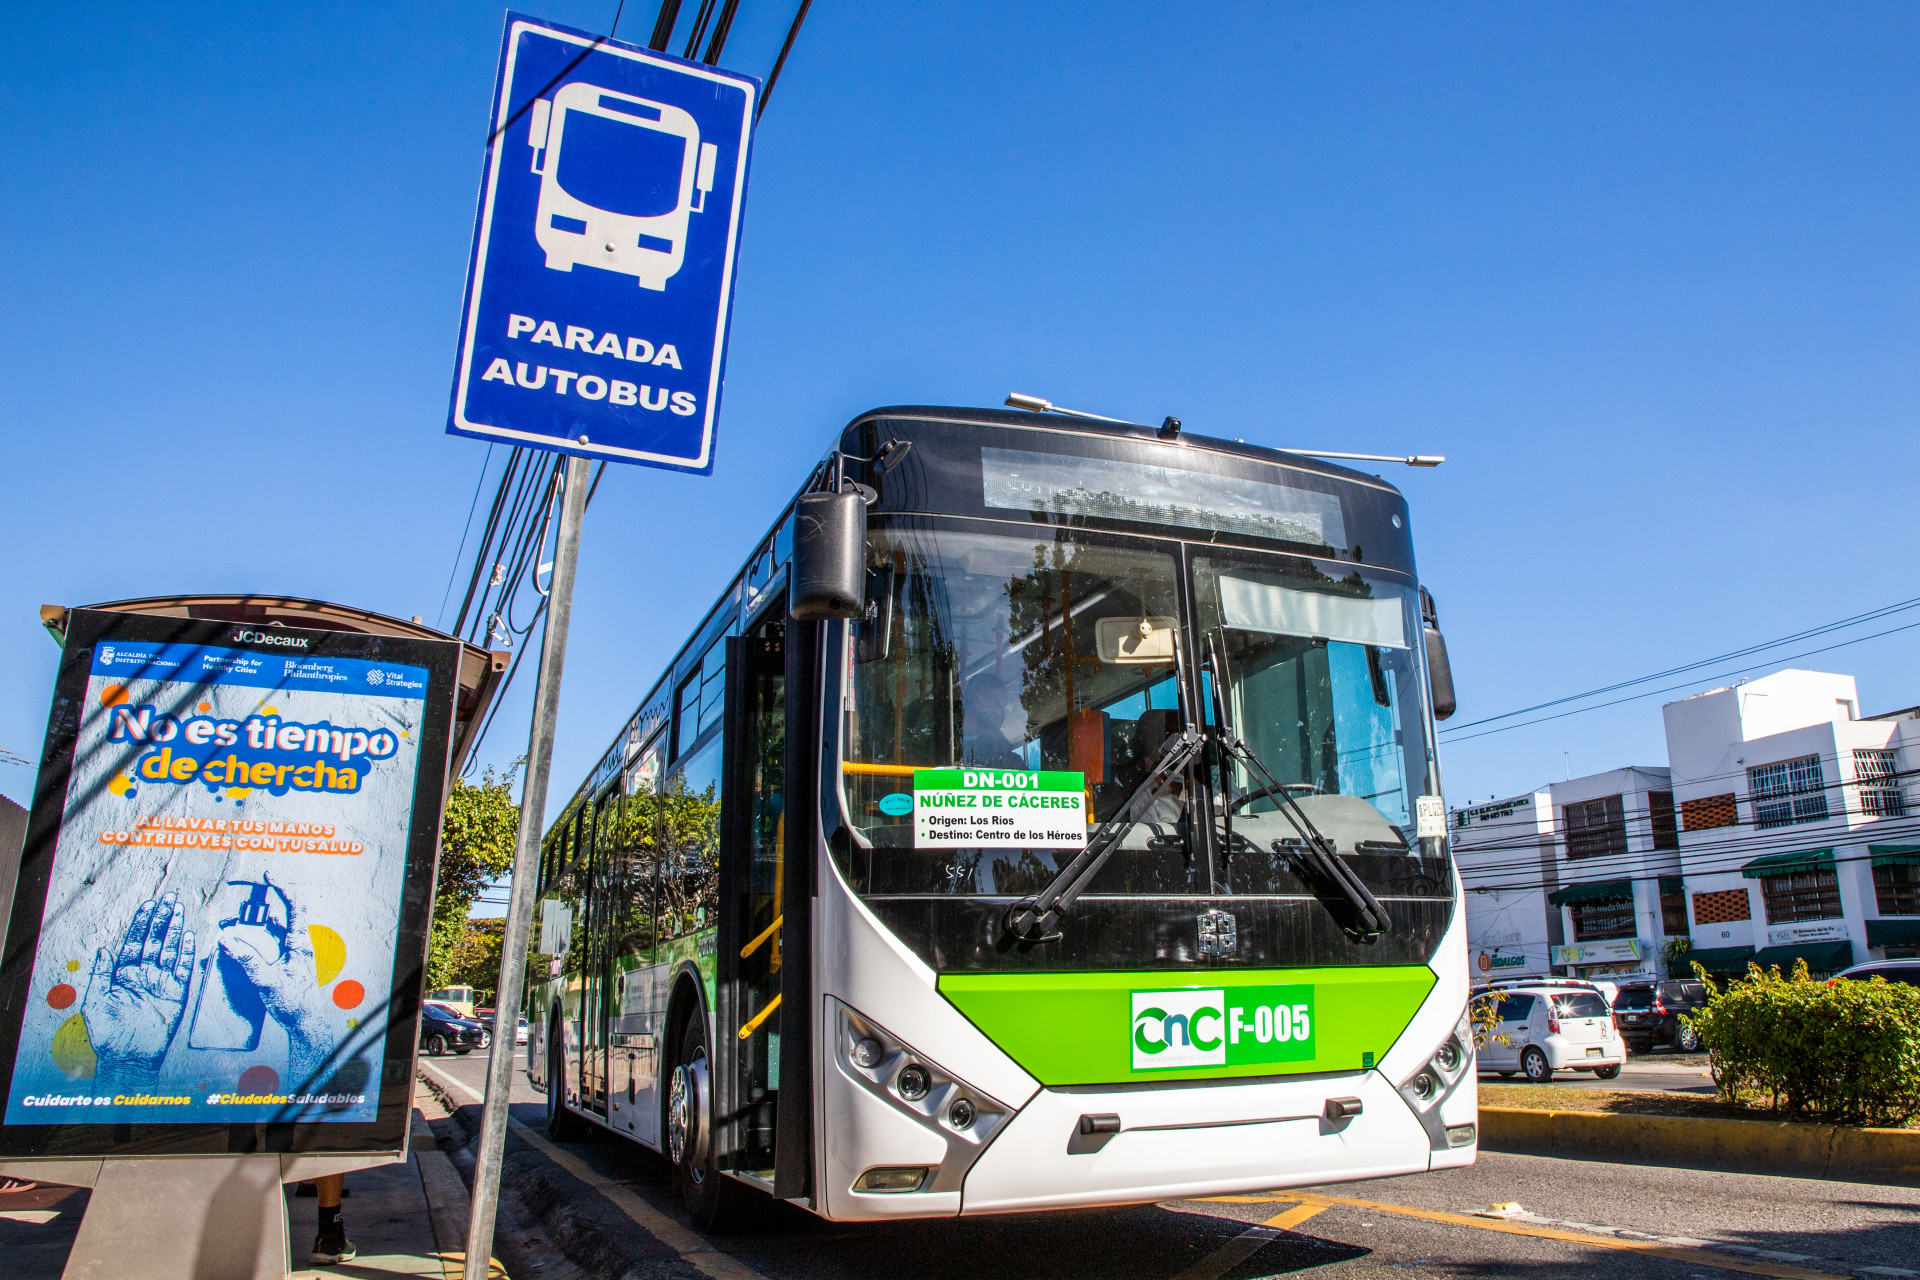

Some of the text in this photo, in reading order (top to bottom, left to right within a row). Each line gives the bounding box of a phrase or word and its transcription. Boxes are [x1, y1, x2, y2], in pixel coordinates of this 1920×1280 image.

[507, 313, 682, 370] PARADA
[481, 358, 697, 416] AUTOBUS
[233, 630, 308, 648] JCDecaux
[147, 659, 180, 667] NACIONAL
[204, 655, 249, 667] Partnership
[285, 660, 334, 673] Bloomberg
[203, 663, 257, 674] Healthy Cities
[283, 669, 348, 682] Philanthropies
[386, 672, 403, 680] Vital
[385, 678, 422, 689] Strategies
[113, 708, 394, 761] No es tiempo
[141, 747, 357, 790] de chercha
[963, 772, 1039, 788] DN-001
[920, 792, 977, 808] NÚÑEZ
[982, 795, 1002, 808] DE
[1008, 792, 1080, 809] CÁCERES
[137, 815, 335, 836] AL LAVAR TUS MANOS
[929, 815, 1014, 827] Origen: Los Ríos
[102, 830, 363, 854] CONTRIBUYES CON TU SALUD
[929, 830, 1082, 841] Destino: Centro de los Héroes
[1491, 955, 1525, 968] HIDALGOS
[1134, 1006, 1223, 1055] CnC
[1229, 1004, 1310, 1044] F-005
[1136, 1055, 1167, 1063] CORREDOR
[23, 1093, 191, 1106] Cuidarte es Cuidarnos
[206, 1092, 365, 1105] #CiudadesSaludables
